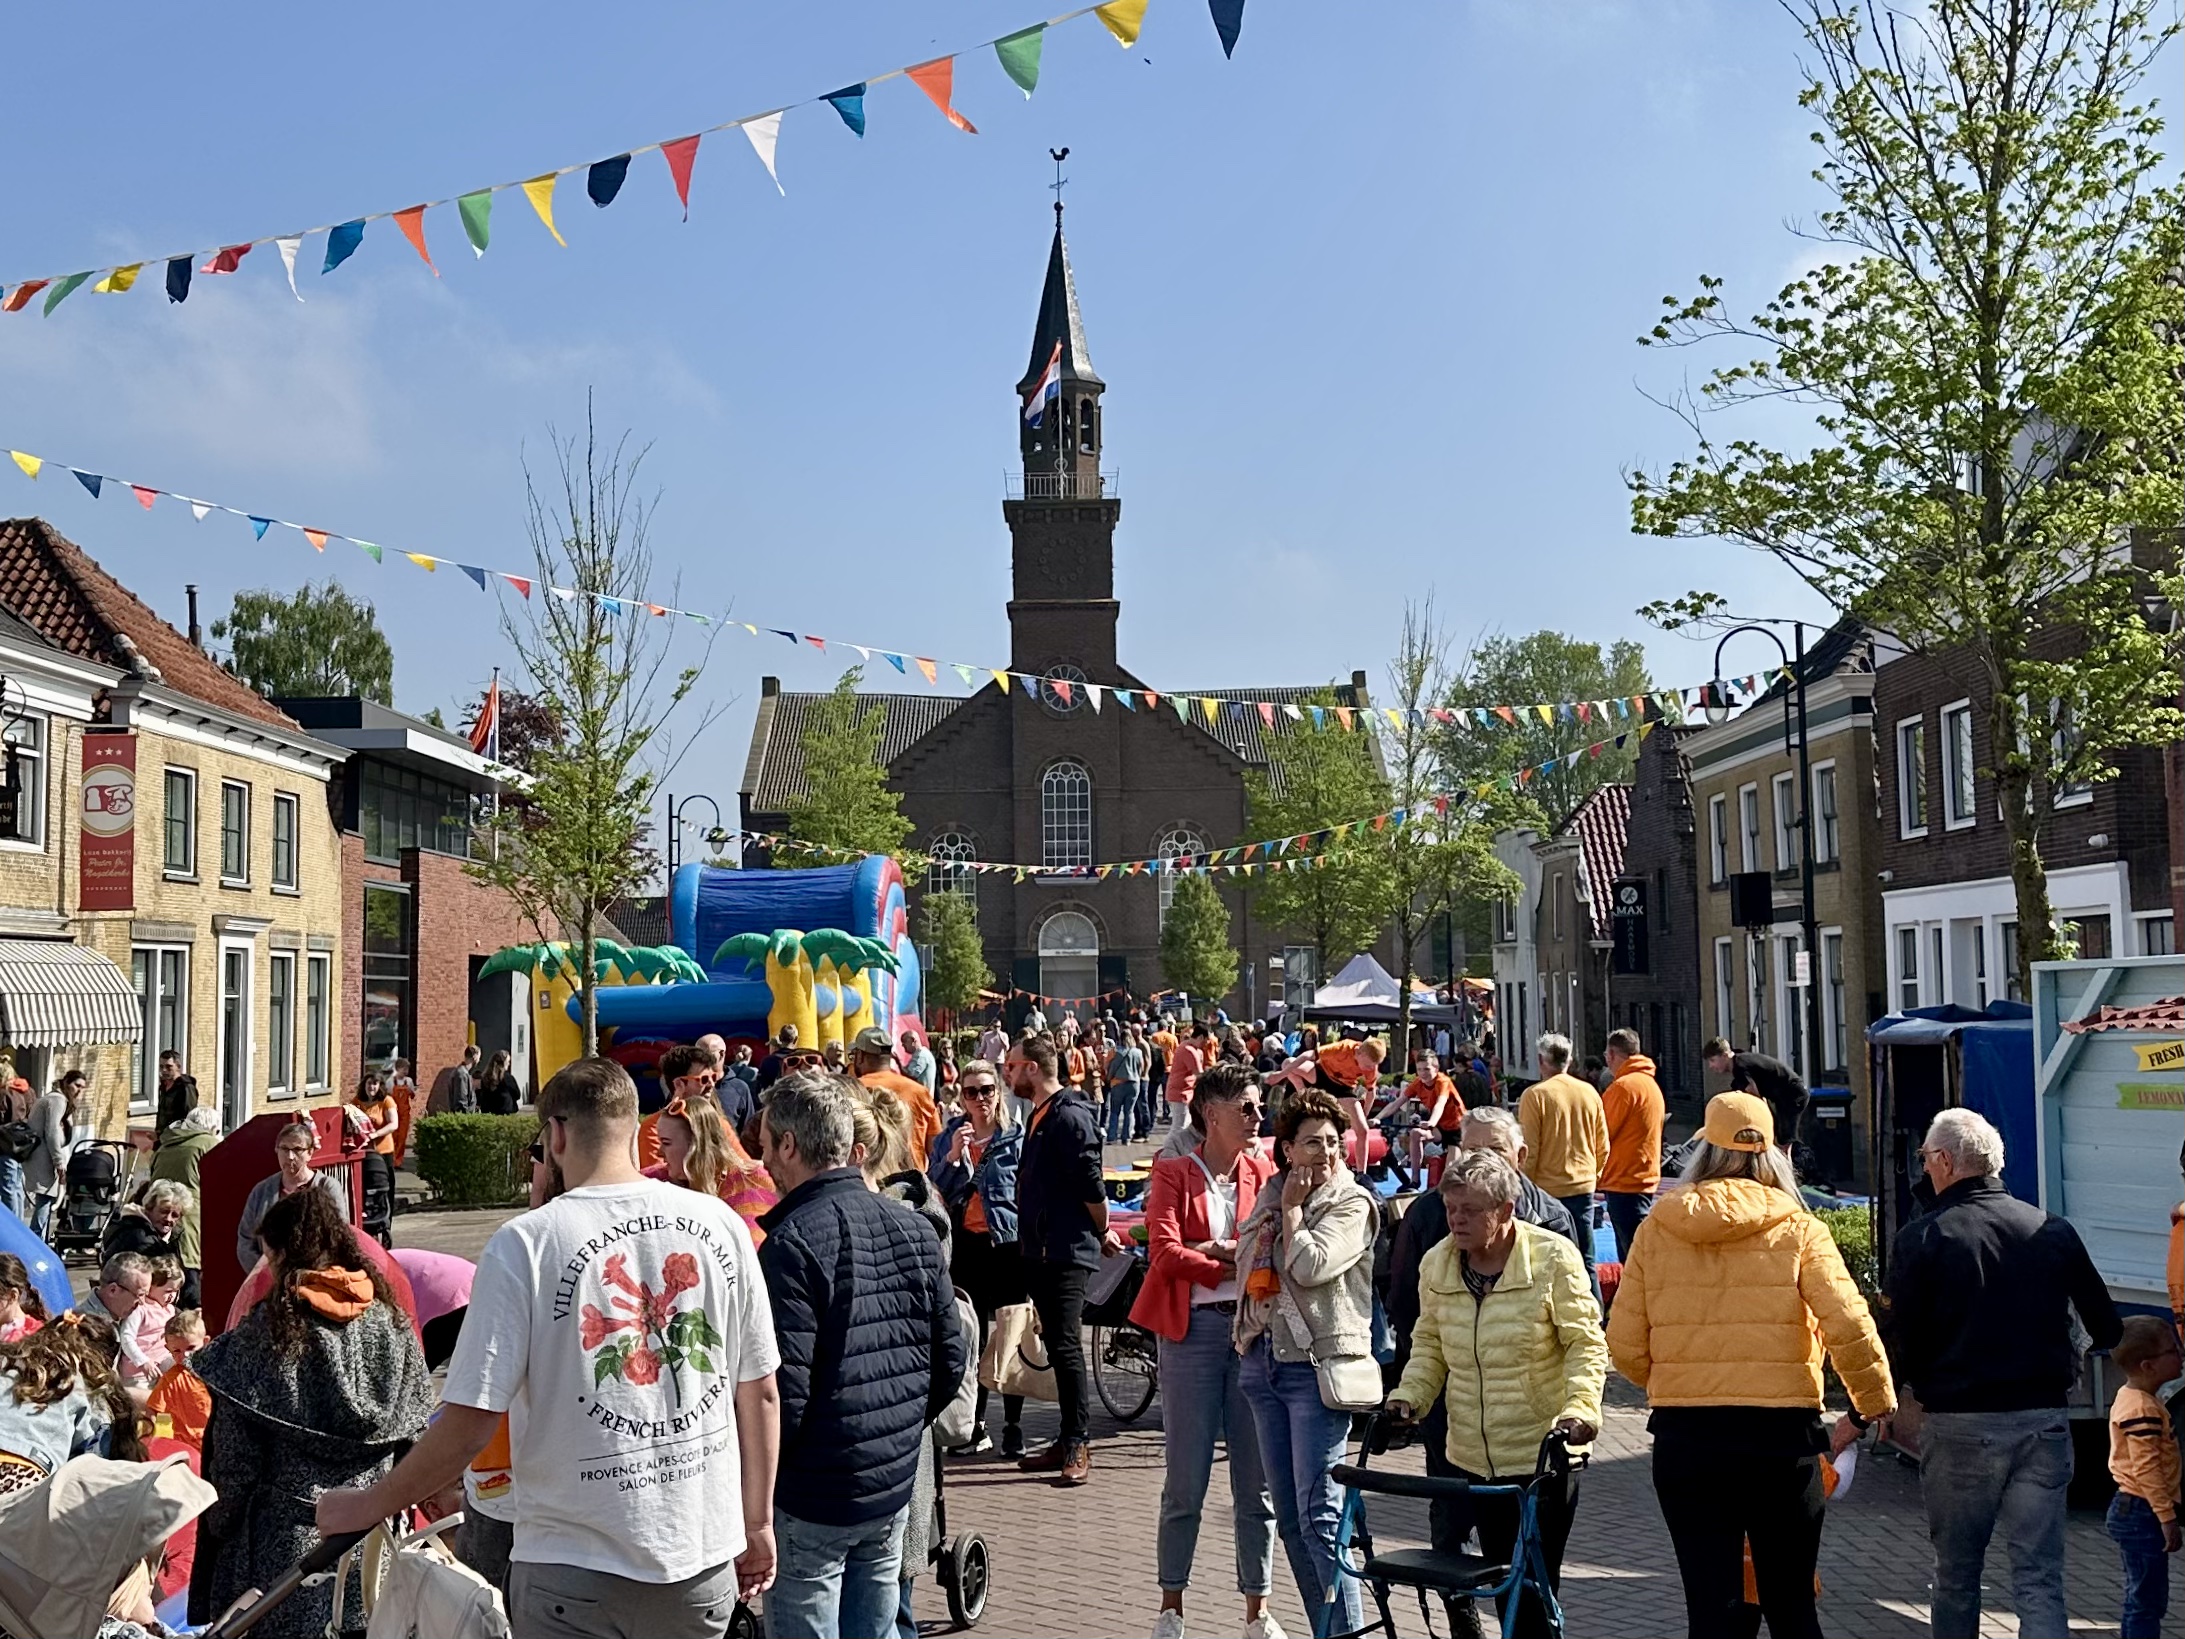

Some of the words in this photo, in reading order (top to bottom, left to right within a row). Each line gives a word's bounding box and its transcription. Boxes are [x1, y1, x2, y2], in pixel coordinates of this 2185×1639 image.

[1616, 904, 1644, 916] MAX
[2147, 1043, 2185, 1067] FRESH
[1115, 1182, 1126, 1198] 8
[586, 1401, 666, 1439] FRENCH
[671, 1374, 728, 1434] RIVIERA
[580, 1462, 643, 1482] PROVENCE
[618, 1474, 657, 1492] SALON
[660, 1471, 675, 1484] DE
